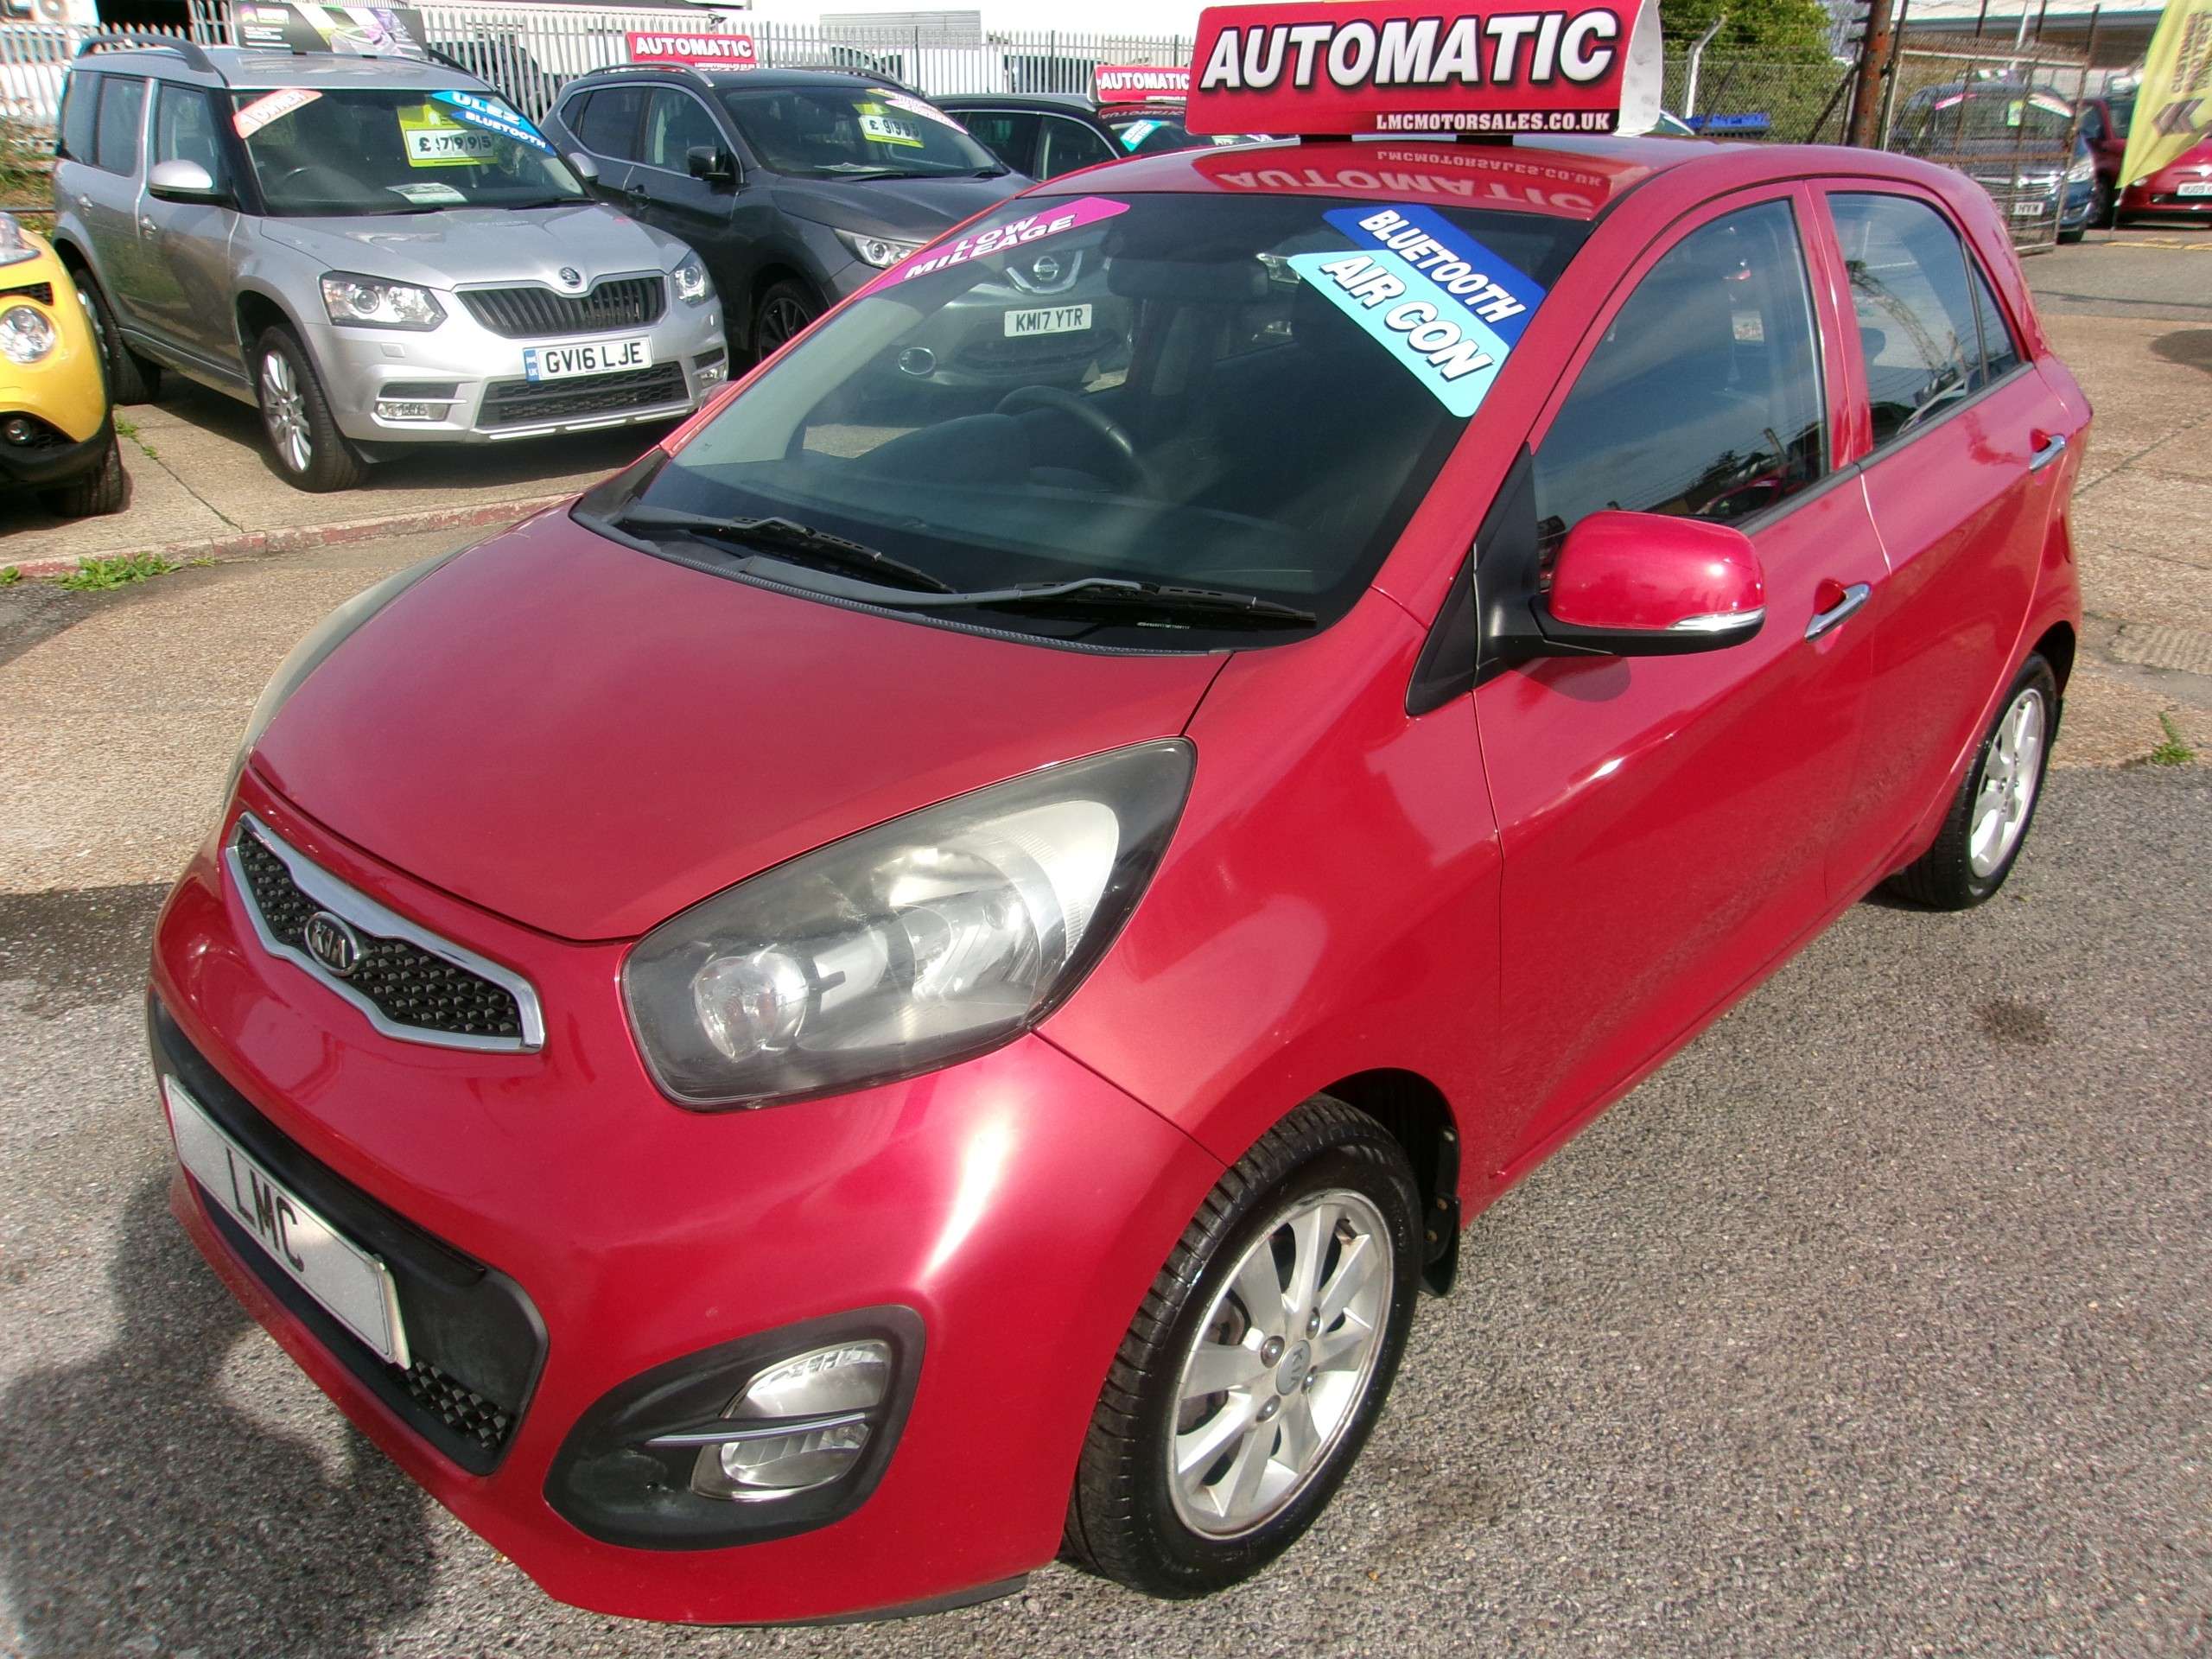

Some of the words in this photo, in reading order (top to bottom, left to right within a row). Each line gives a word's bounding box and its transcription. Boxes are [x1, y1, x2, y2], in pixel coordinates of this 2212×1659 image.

[636, 36, 753, 58] AUTOMATIC
[1201, 10, 1618, 88] AUTOMATIC
[1101, 73, 1189, 90] AUTOMATIC
[452, 90, 522, 126] ULEZ
[1376, 111, 1610, 131] LMCMOTORSALES.CO.UK
[465, 111, 546, 149] BLUETOOTH
[905, 214, 1077, 279] MILEAGE
[955, 216, 1039, 252] LOW
[1358, 209, 1527, 323] BLUETOOTH
[1015, 311, 1051, 333] KM17
[1056, 308, 1083, 327] YTR
[1319, 255, 1407, 310] AIR
[1384, 301, 1495, 382] CON
[546, 347, 596, 373] GV16
[601, 342, 644, 367] LJE
[310, 920, 347, 967] KIA
[226, 1147, 305, 1274] LMC
